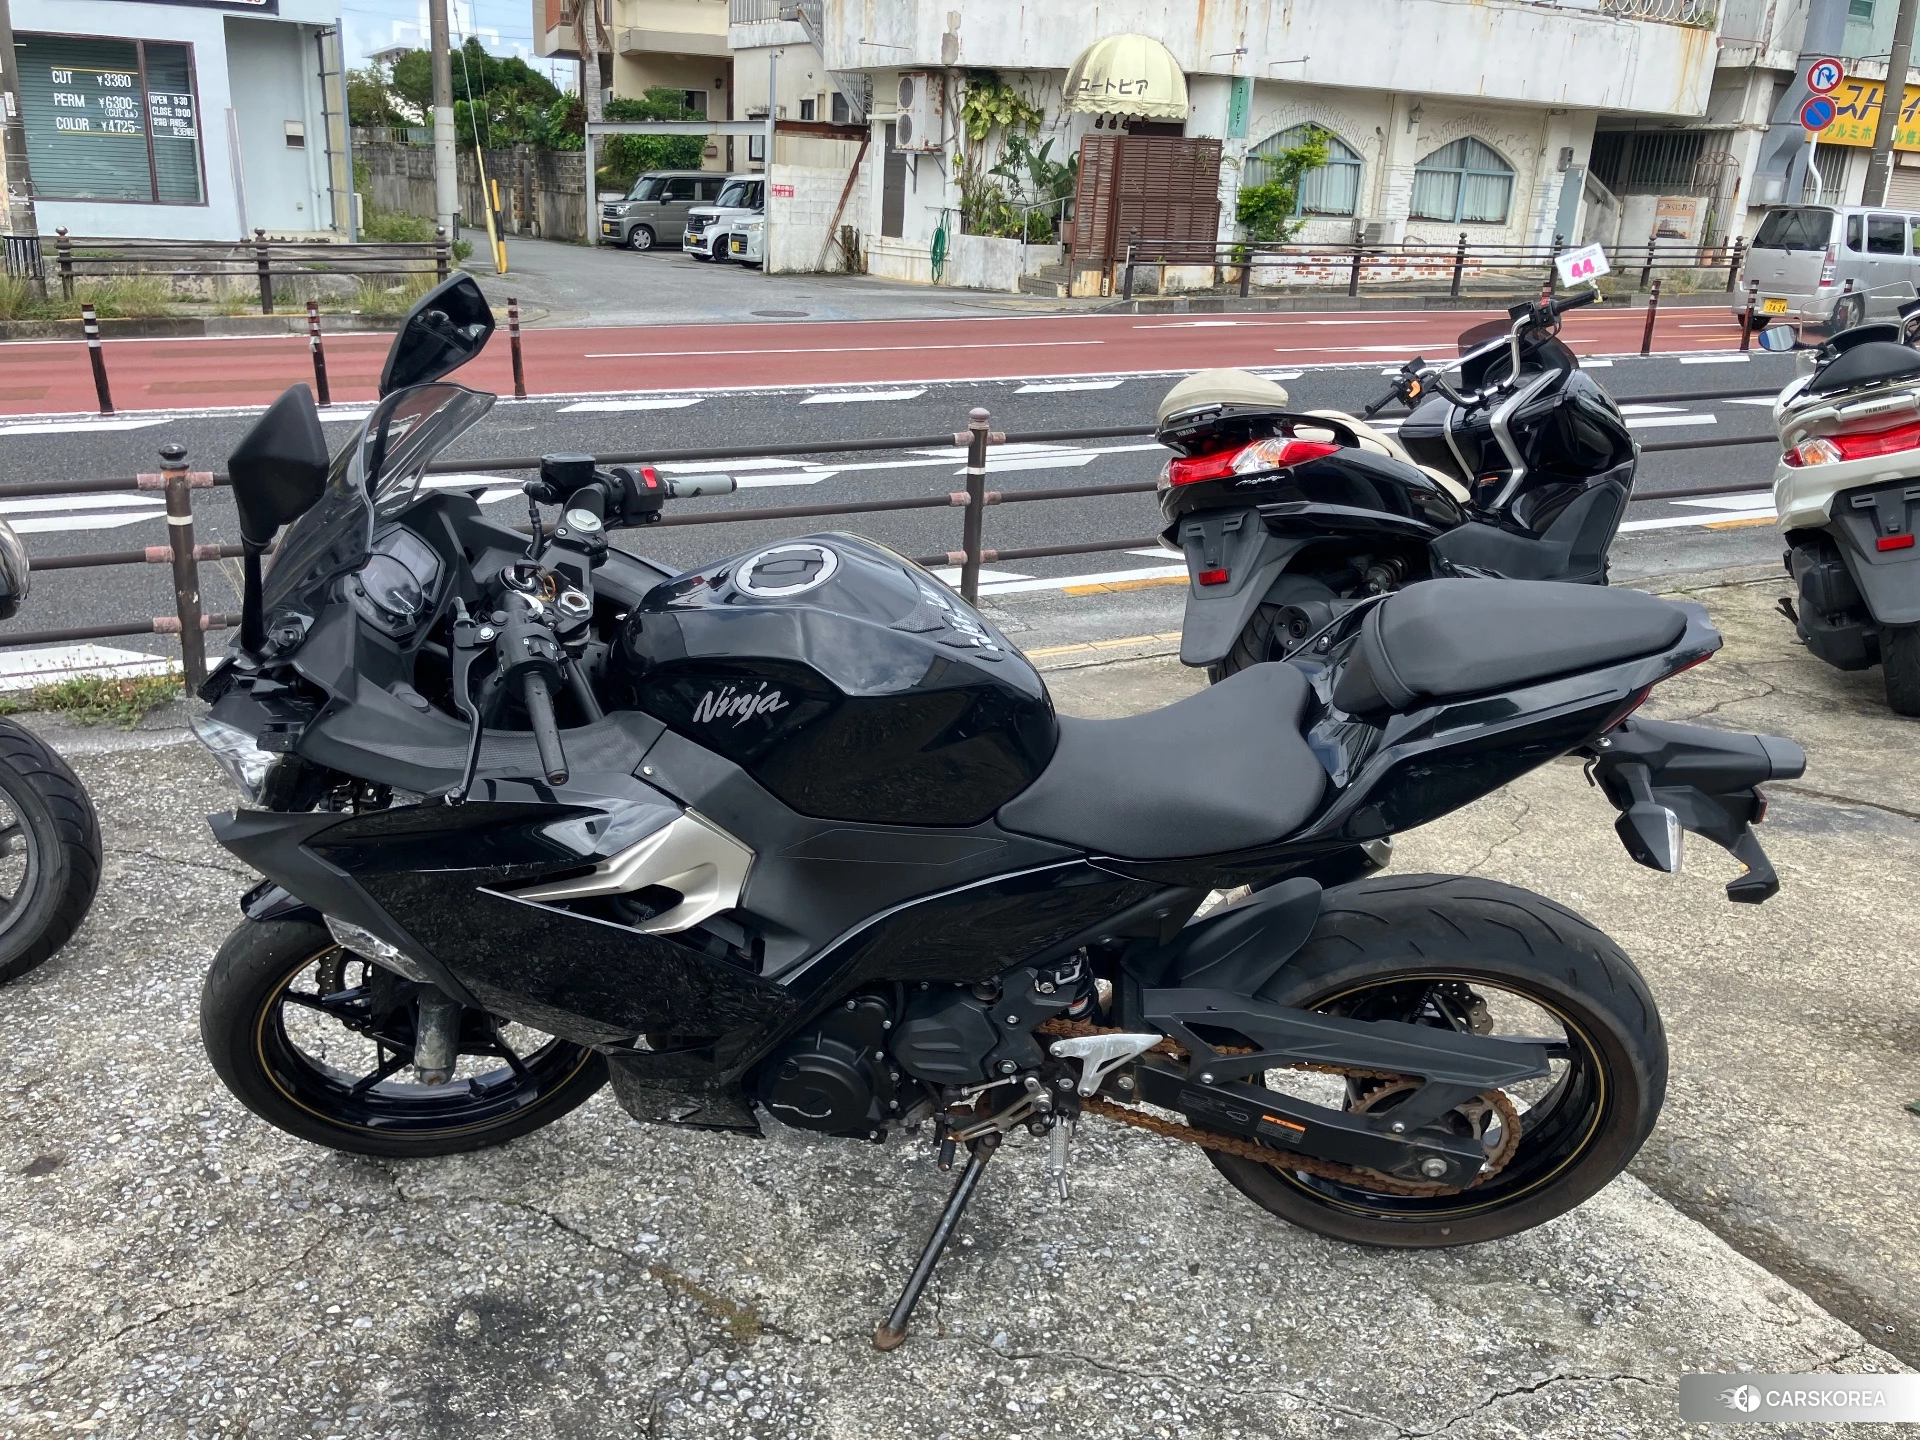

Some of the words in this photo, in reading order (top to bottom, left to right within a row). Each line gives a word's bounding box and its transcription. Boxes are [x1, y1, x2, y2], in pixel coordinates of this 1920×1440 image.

[52, 70, 73, 84] CUT
[1078, 77, 1149, 96] ユートピア
[53, 92, 86, 108] PERM
[150, 95, 168, 104] OPEN
[152, 105, 173, 116] CLOSE
[56, 116, 90, 131] COLOR
[1571, 258, 1595, 278] 44
[1864, 404, 1891, 414] YAMAHA
[692, 681, 790, 729] Ninja
